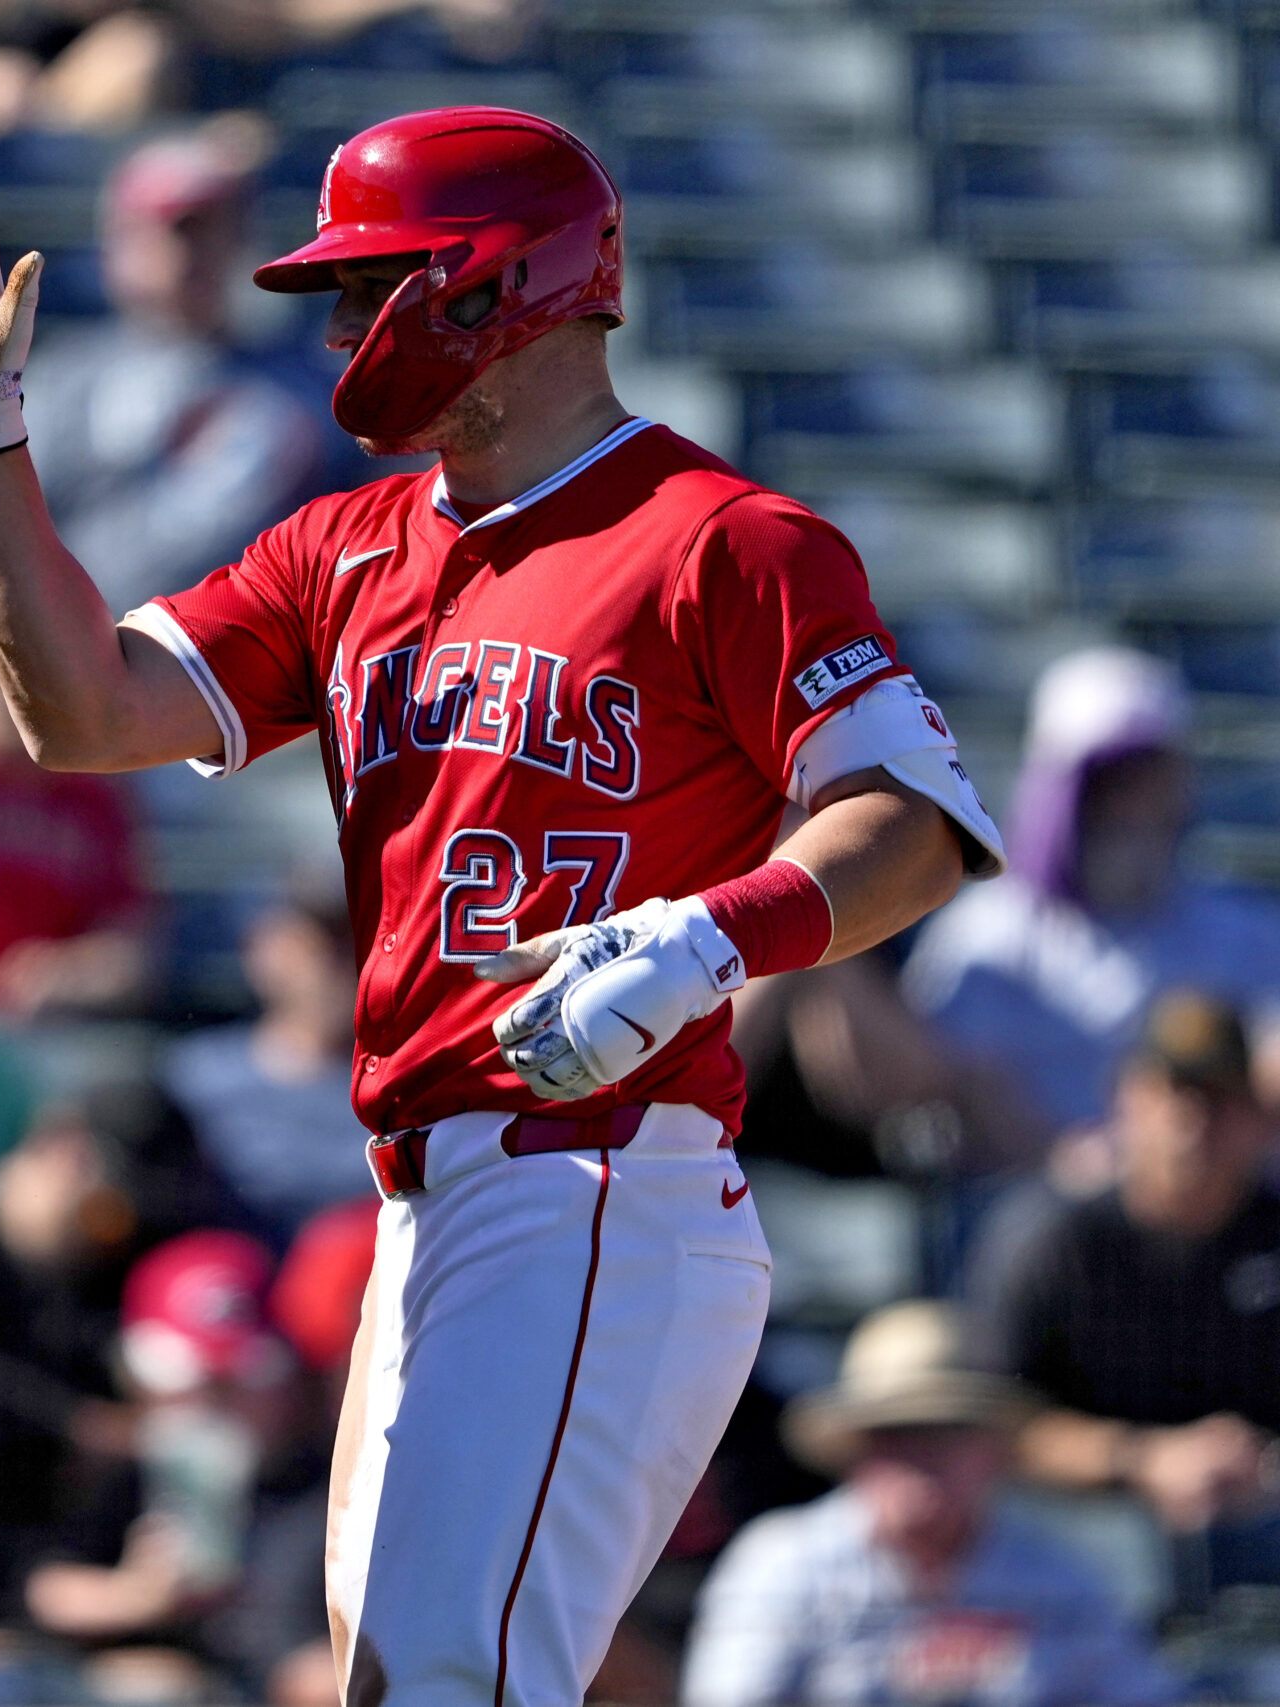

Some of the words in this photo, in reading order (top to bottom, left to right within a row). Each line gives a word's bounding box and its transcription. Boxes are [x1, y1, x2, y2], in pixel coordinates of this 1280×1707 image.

[833, 640, 880, 674] FBM
[326, 640, 640, 842] ANGELS
[438, 828, 630, 963] 27
[715, 954, 739, 984] 27
